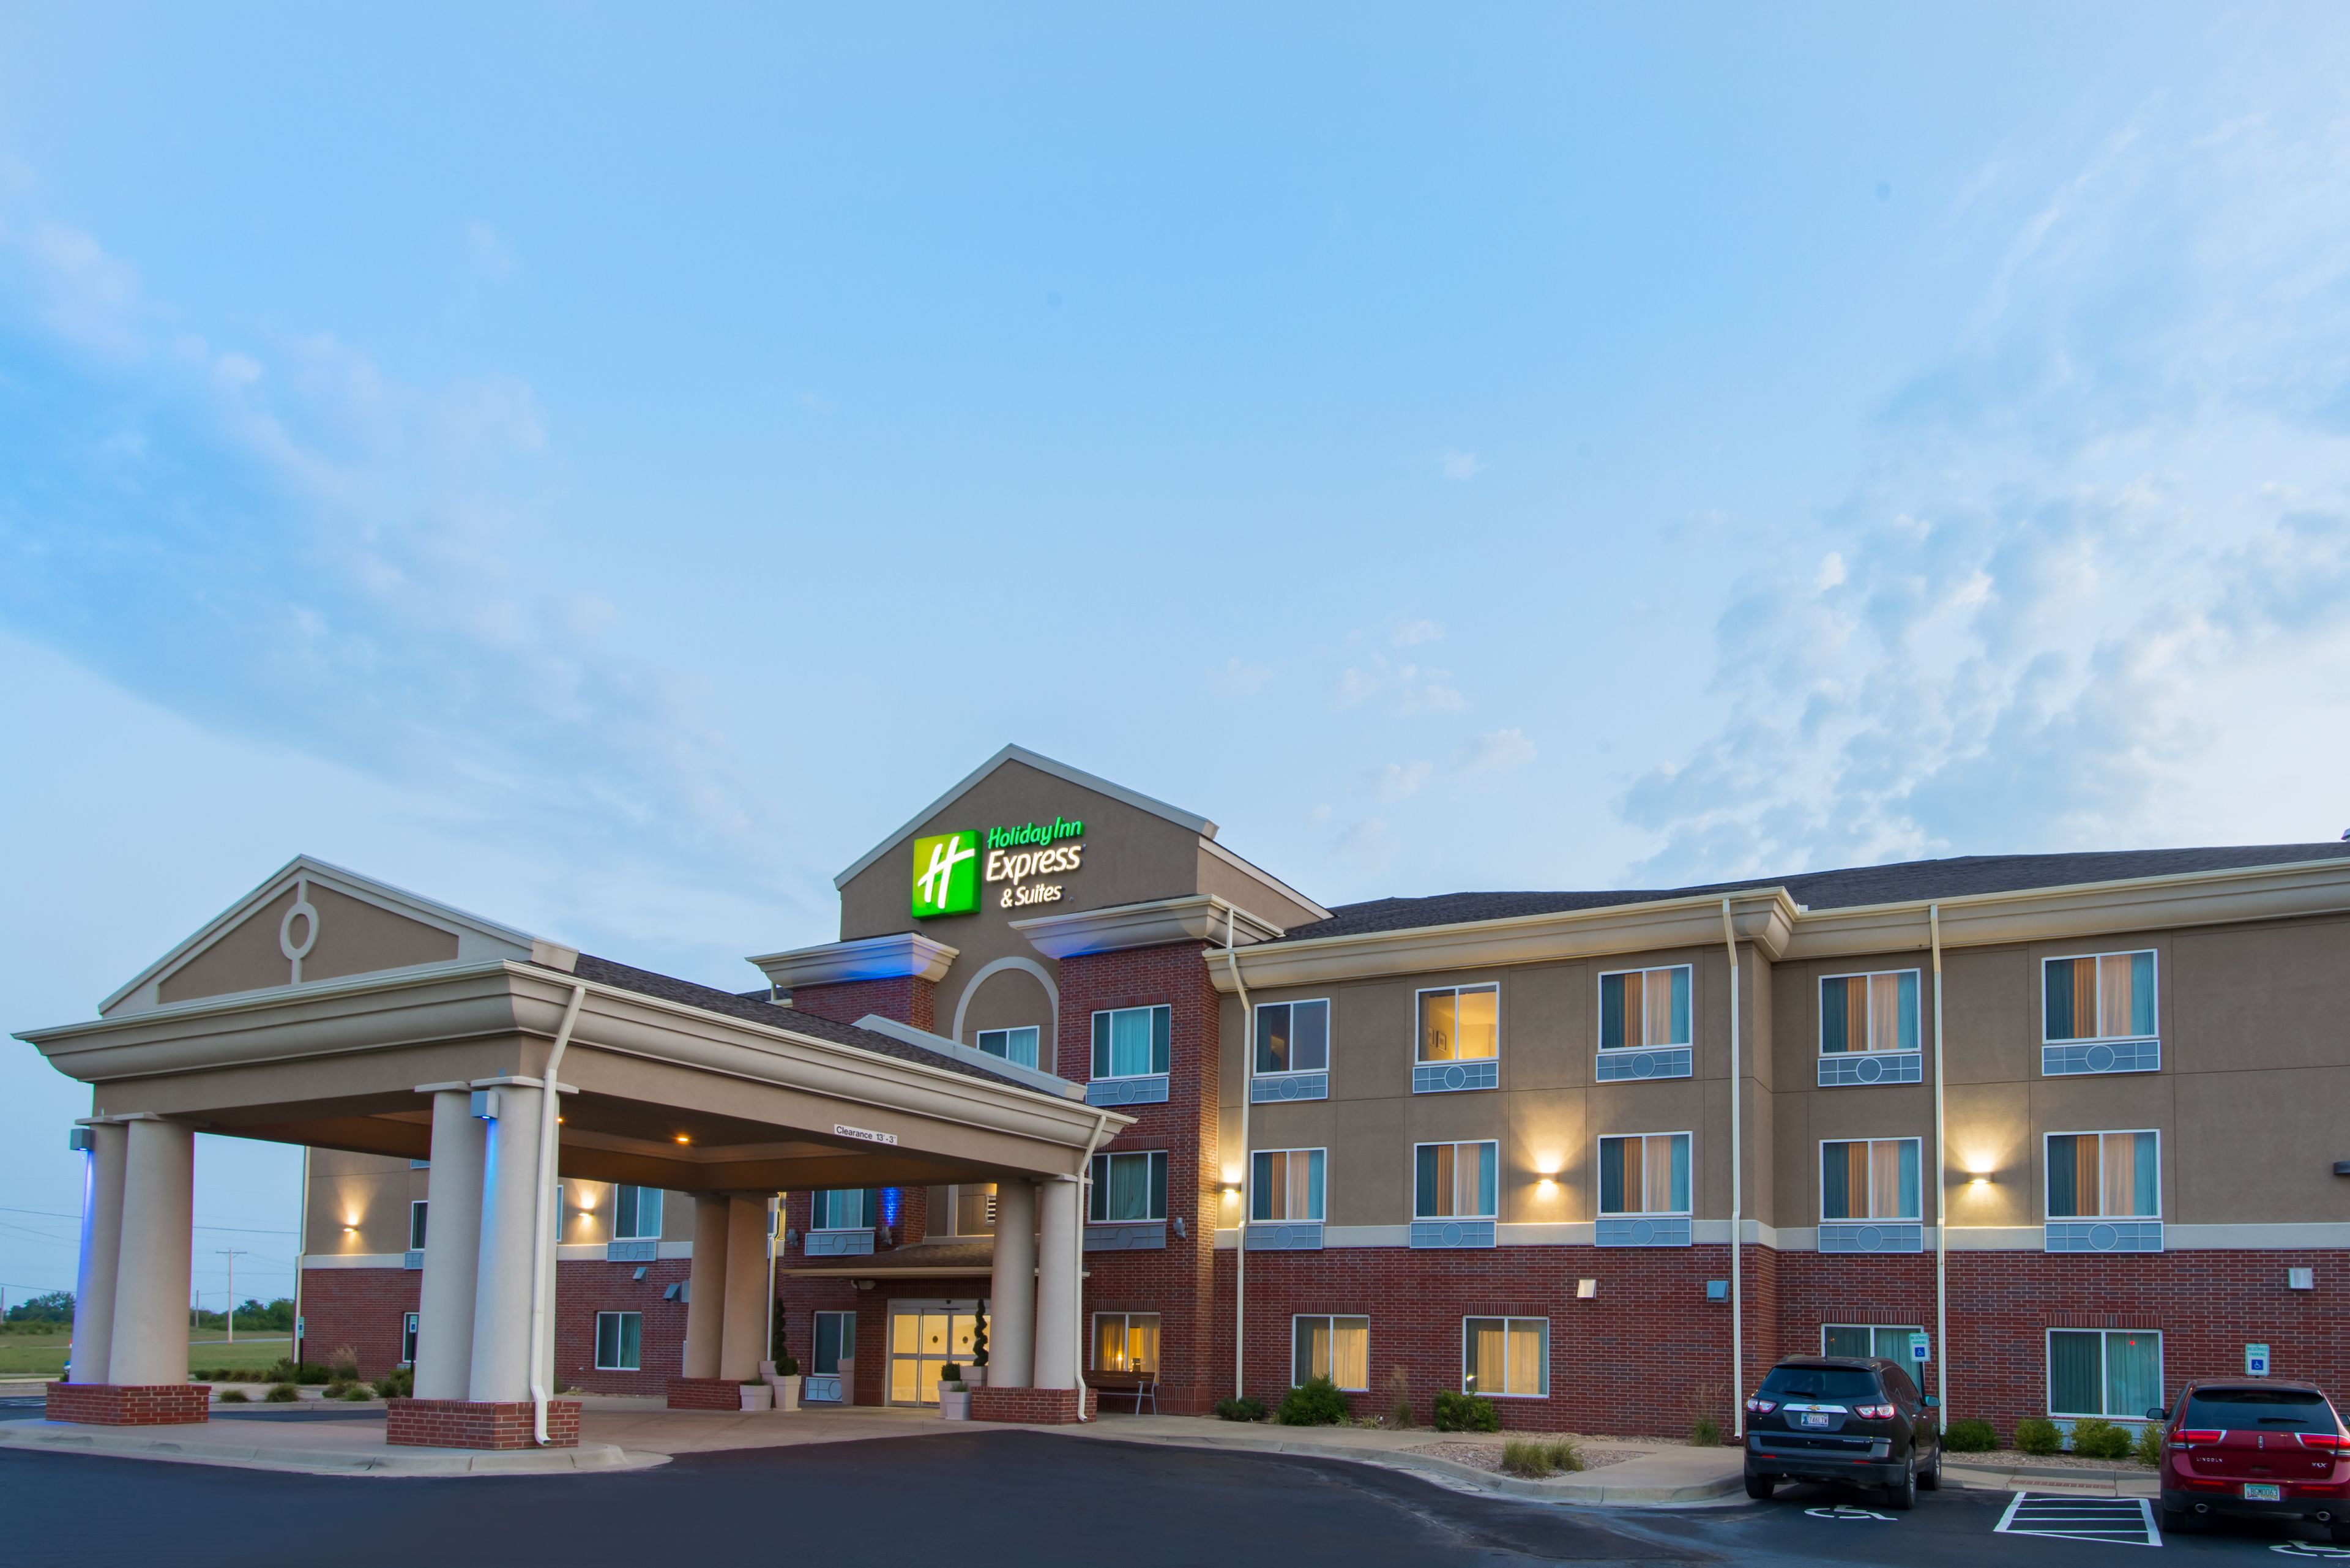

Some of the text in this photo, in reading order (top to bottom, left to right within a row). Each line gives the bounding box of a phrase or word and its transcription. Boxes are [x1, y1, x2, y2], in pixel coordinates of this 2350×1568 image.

[987, 816, 1084, 849] Holiday Inn
[985, 845, 1083, 886] Express
[1000, 884, 1064, 908] & Suites
[836, 1126, 873, 1140] Clearance
